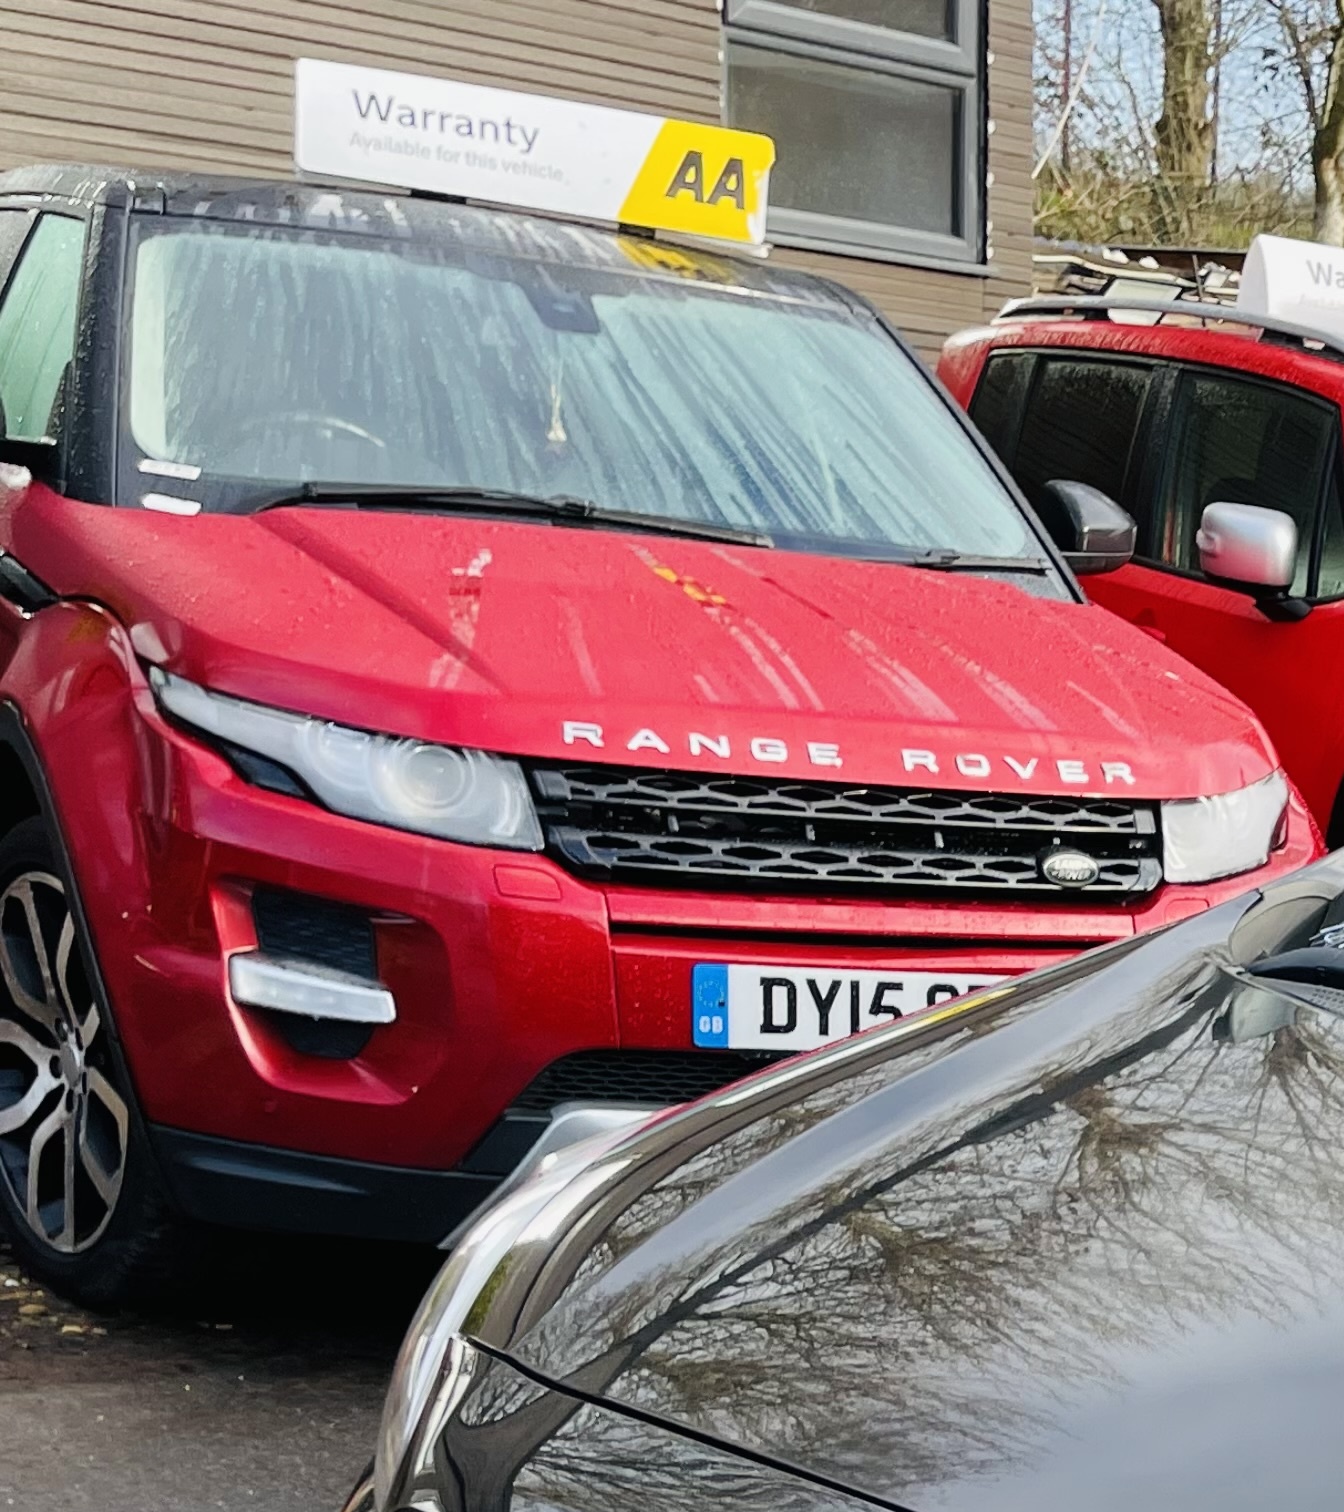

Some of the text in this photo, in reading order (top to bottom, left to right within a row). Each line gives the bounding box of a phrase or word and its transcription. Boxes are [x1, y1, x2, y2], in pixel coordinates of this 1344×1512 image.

[351, 88, 540, 154] Warranty
[350, 132, 432, 160] Available
[436, 145, 461, 165] for
[464, 149, 498, 171] this
[665, 150, 745, 210] AA
[561, 720, 1137, 785] RANGE ROVER
[759, 976, 905, 1036] DY15
